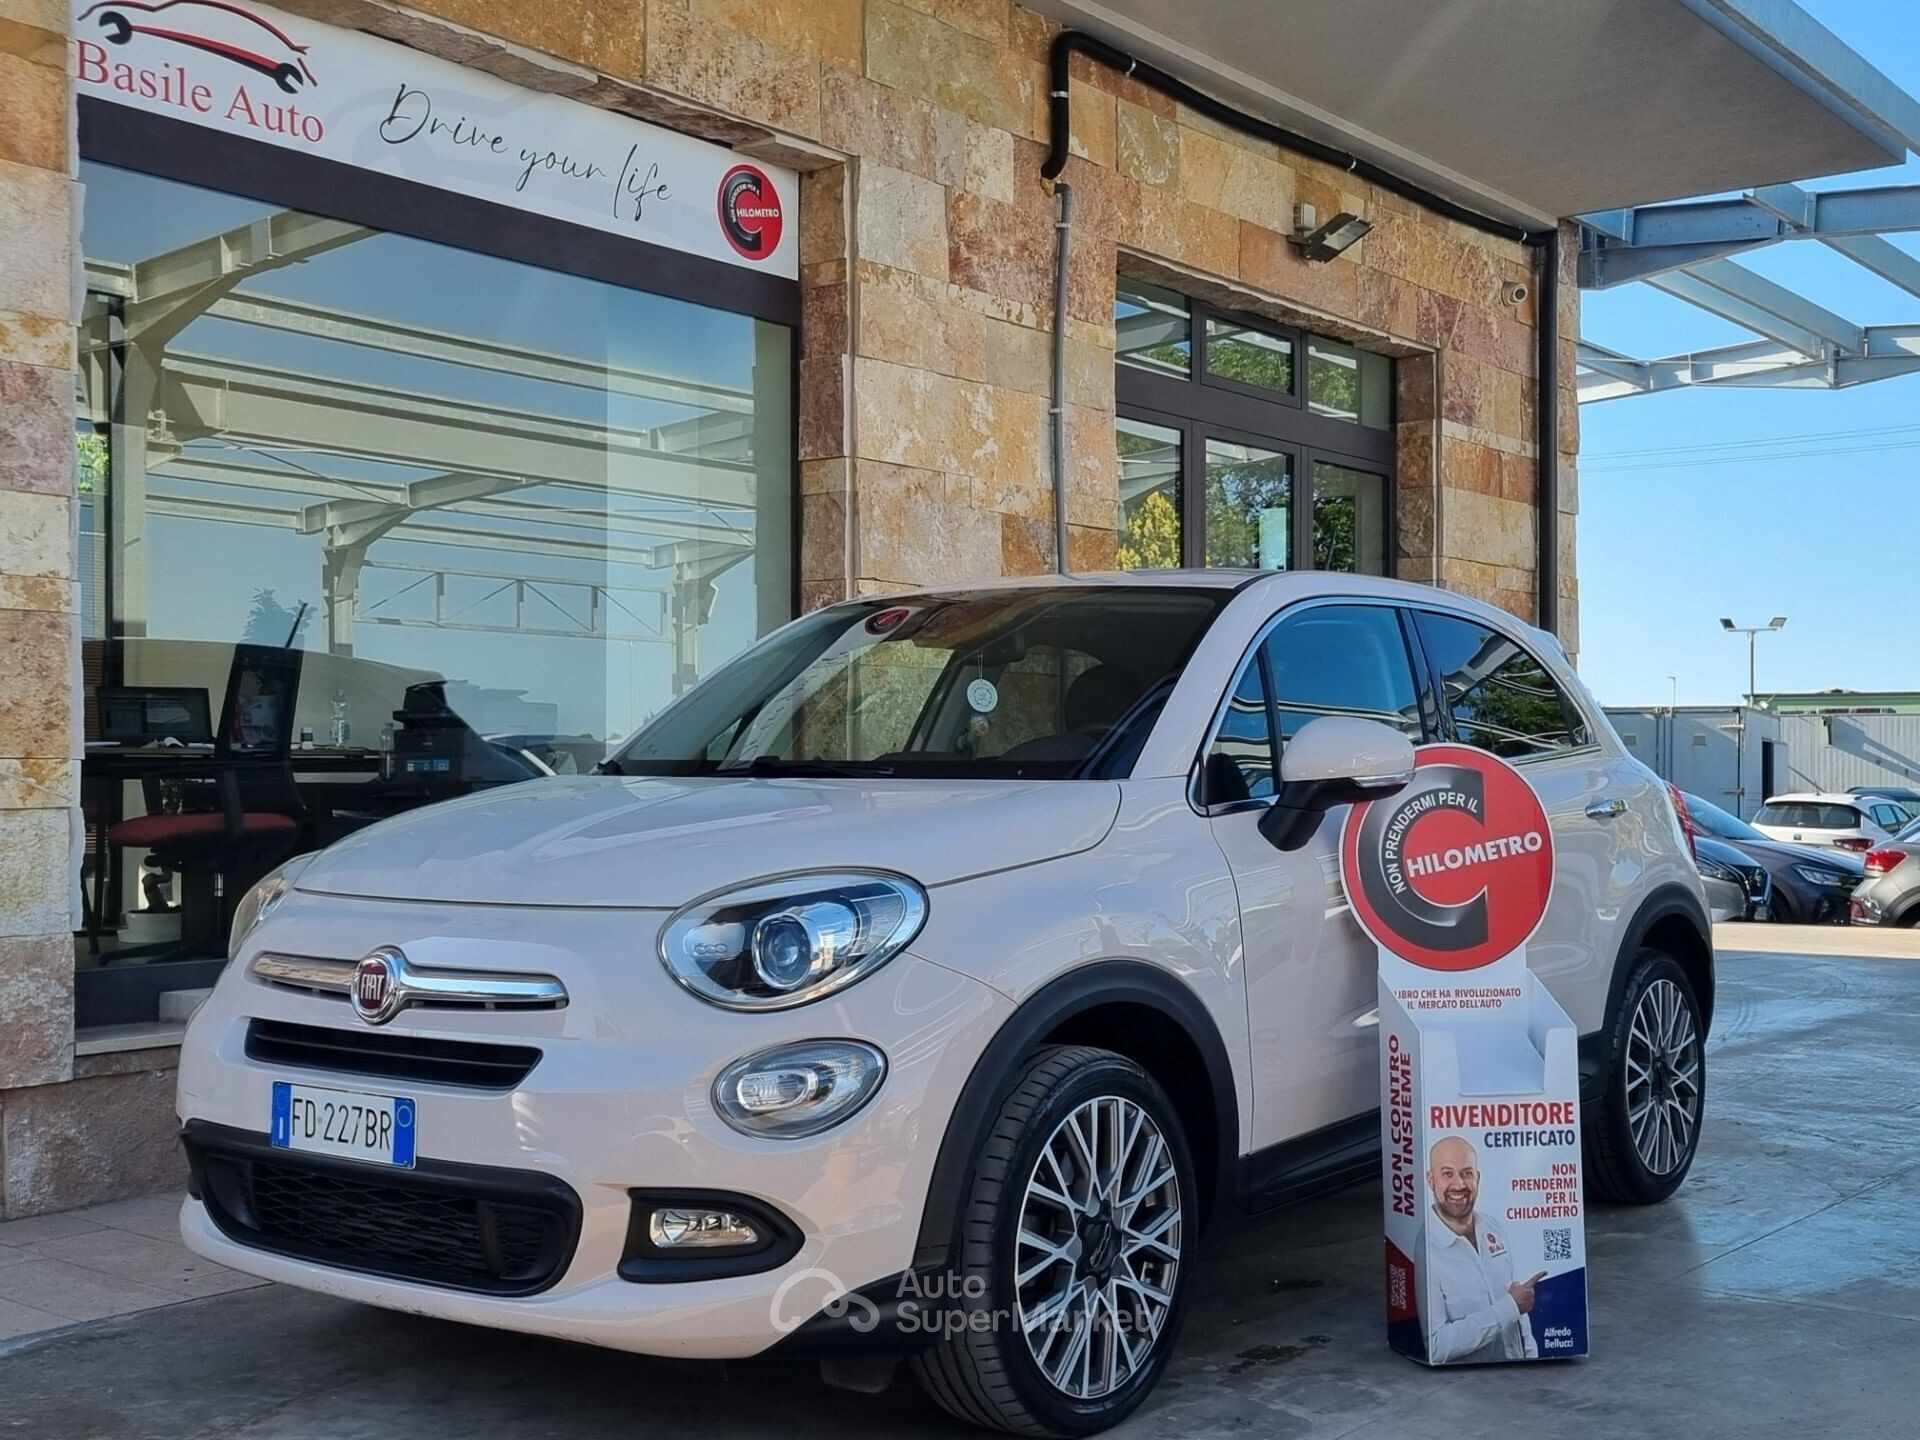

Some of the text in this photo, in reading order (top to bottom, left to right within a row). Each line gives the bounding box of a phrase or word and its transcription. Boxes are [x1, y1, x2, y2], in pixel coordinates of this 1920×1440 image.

[75, 39, 324, 142] Basile Auto
[378, 83, 672, 221] Drive your life
[1385, 791, 1479, 894] NON PRENDERMI PER IL
[360, 974, 385, 1001] FIAT
[1421, 989, 1437, 998] CHE
[1439, 989, 1451, 998] HA
[1454, 987, 1521, 998] RIVOLUZIONATO
[1407, 999, 1502, 1010] IL MERCATO DELL'AUTO
[292, 1098, 392, 1151] FD 227BR
[1388, 1034, 1403, 1214] NON CONTRO
[1430, 1102, 1575, 1129] RIVENDITORE
[1400, 1053, 1415, 1217] MA INSIEME
[1484, 1130, 1576, 1148] CERTIFICATO
[1552, 1163, 1576, 1175] NON
[1512, 1178, 1577, 1191] PRENDERMI
[1545, 1191, 1579, 1204] PER IL
[1506, 1205, 1579, 1220] CHILOMETRO
[1544, 1326, 1572, 1337] Alfredo
[1544, 1338, 1574, 1349] Bellucci
